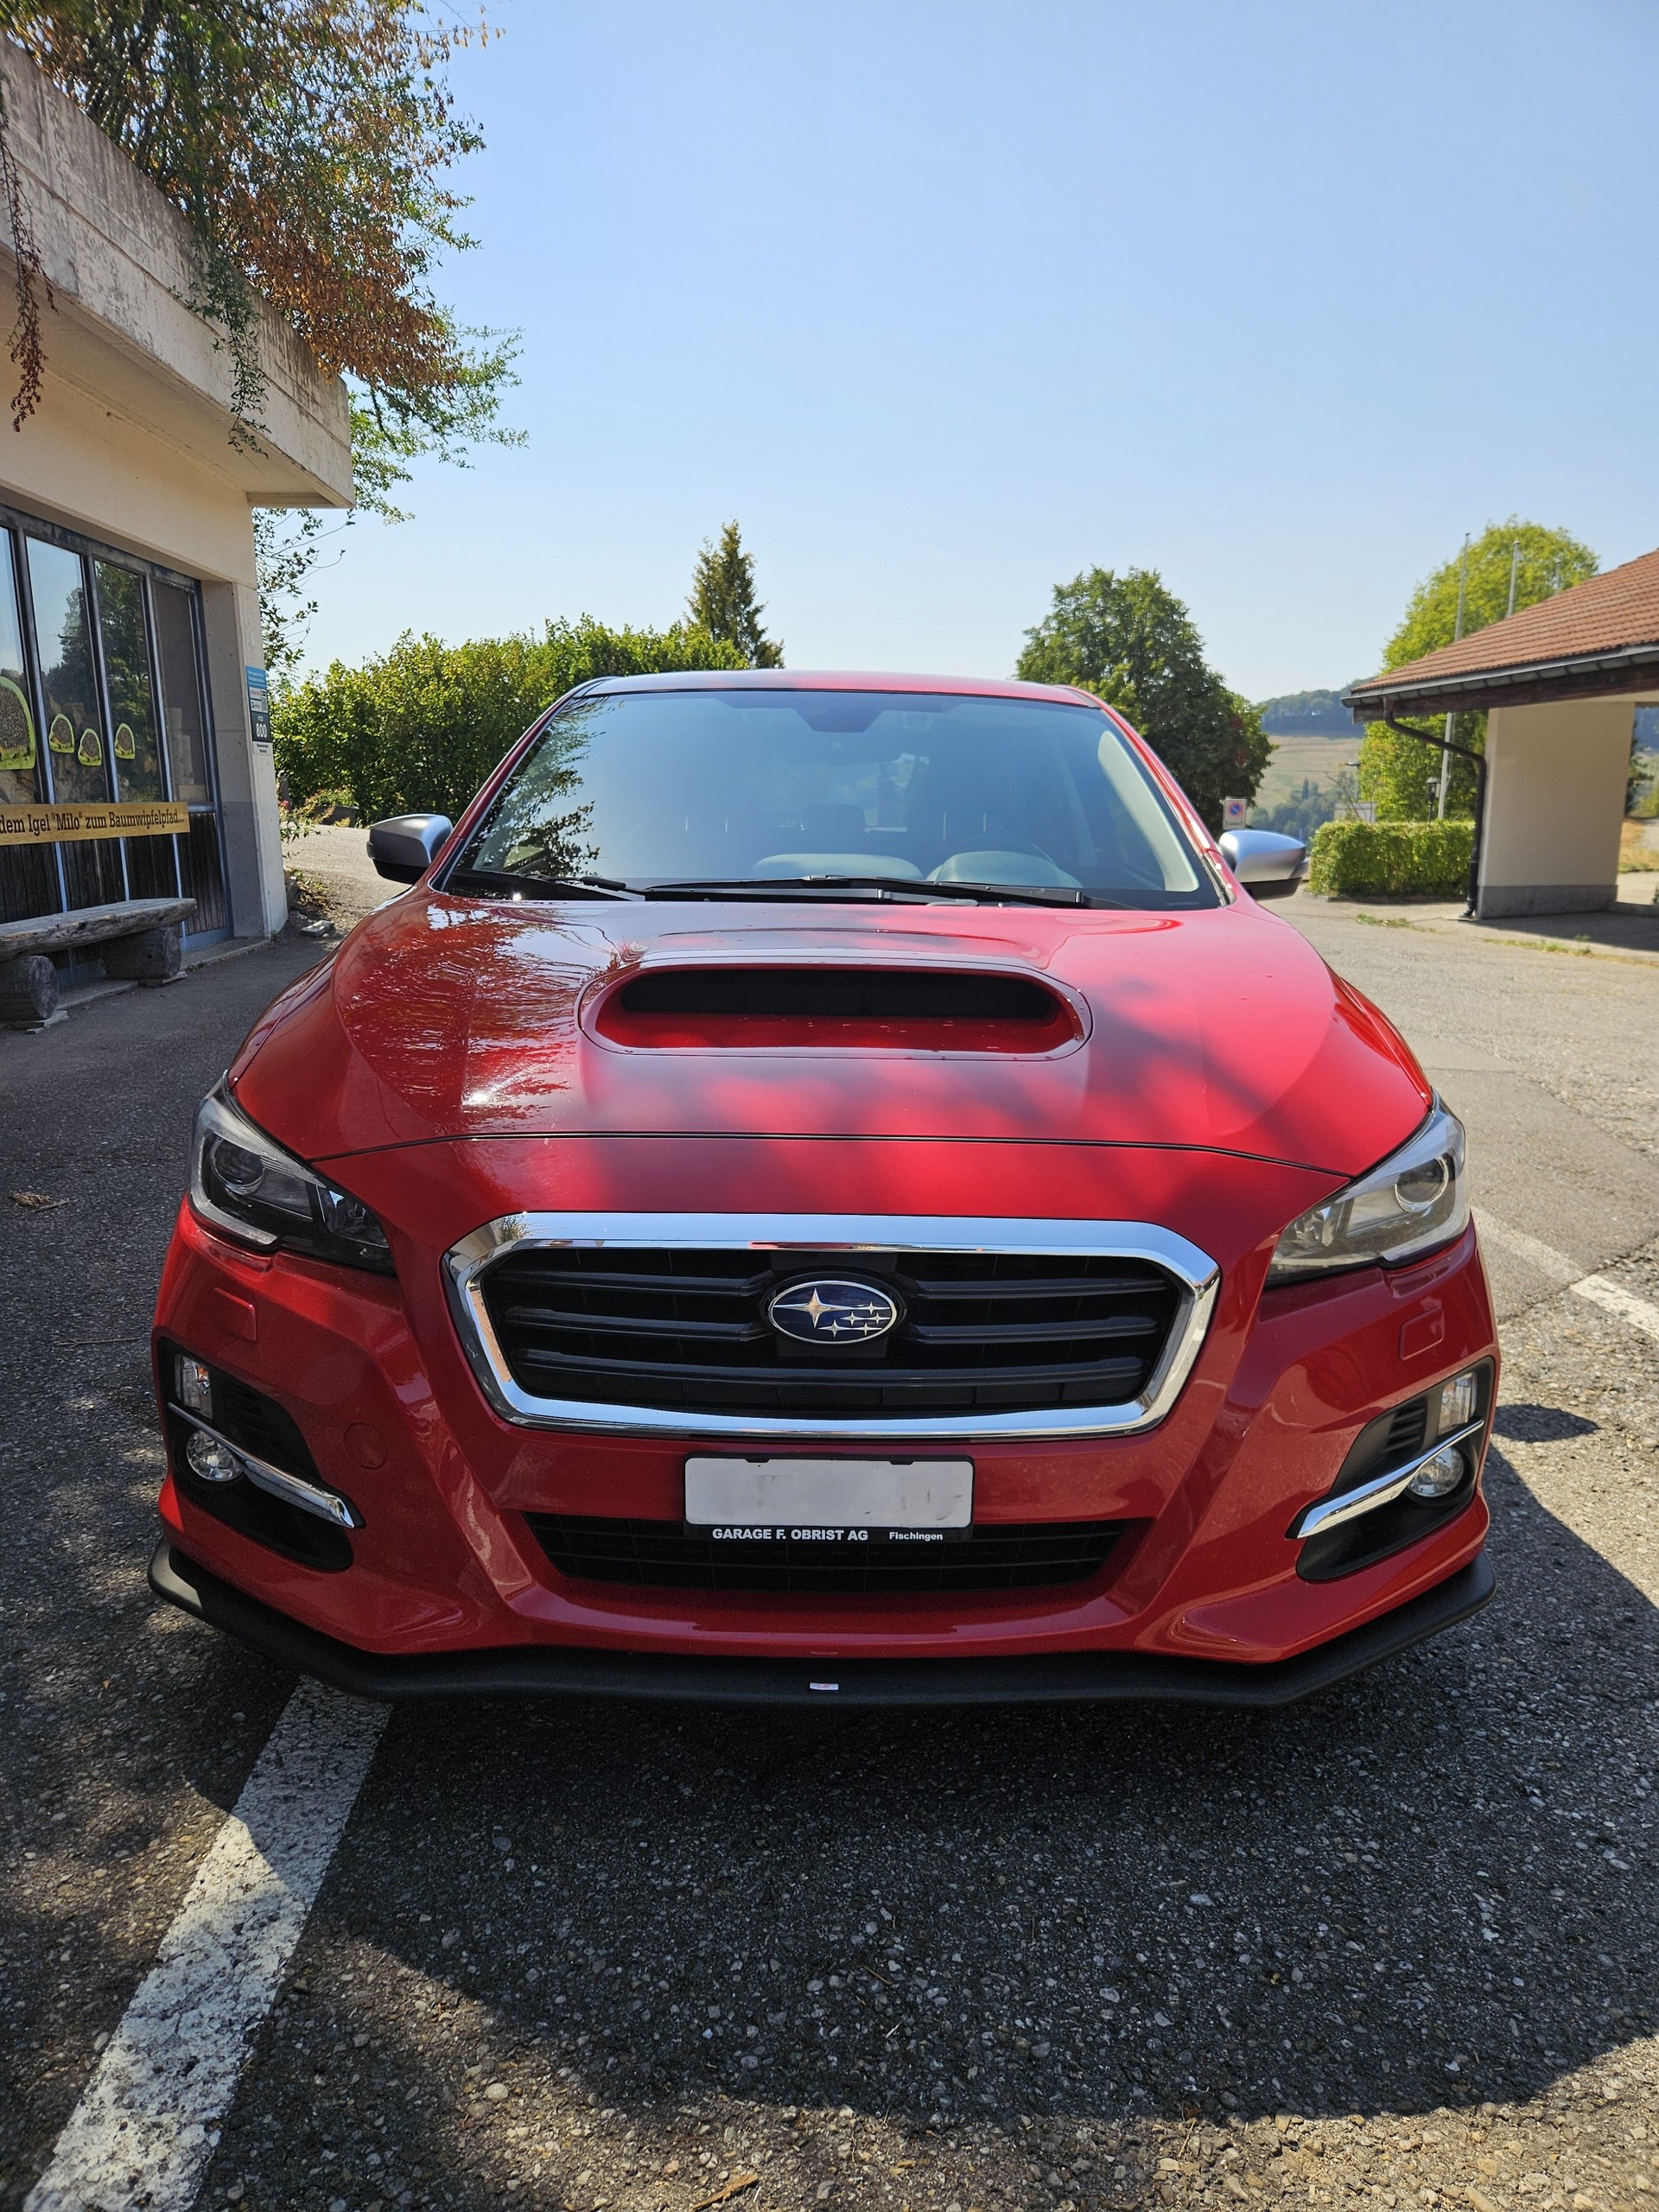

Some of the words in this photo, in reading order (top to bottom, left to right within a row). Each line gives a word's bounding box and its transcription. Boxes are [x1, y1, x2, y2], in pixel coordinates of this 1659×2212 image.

[0, 815, 25, 834] dem
[27, 813, 50, 836] Igel
[51, 811, 82, 831] "Milo"
[86, 816, 107, 829] zum
[108, 810, 185, 829] Baumwipfelpfad...
[712, 1529, 772, 1540] GARAGE
[776, 1529, 786, 1540] F.
[791, 1529, 844, 1541] OBRIST
[847, 1530, 868, 1541] AG
[889, 1532, 944, 1541] Fischingen
